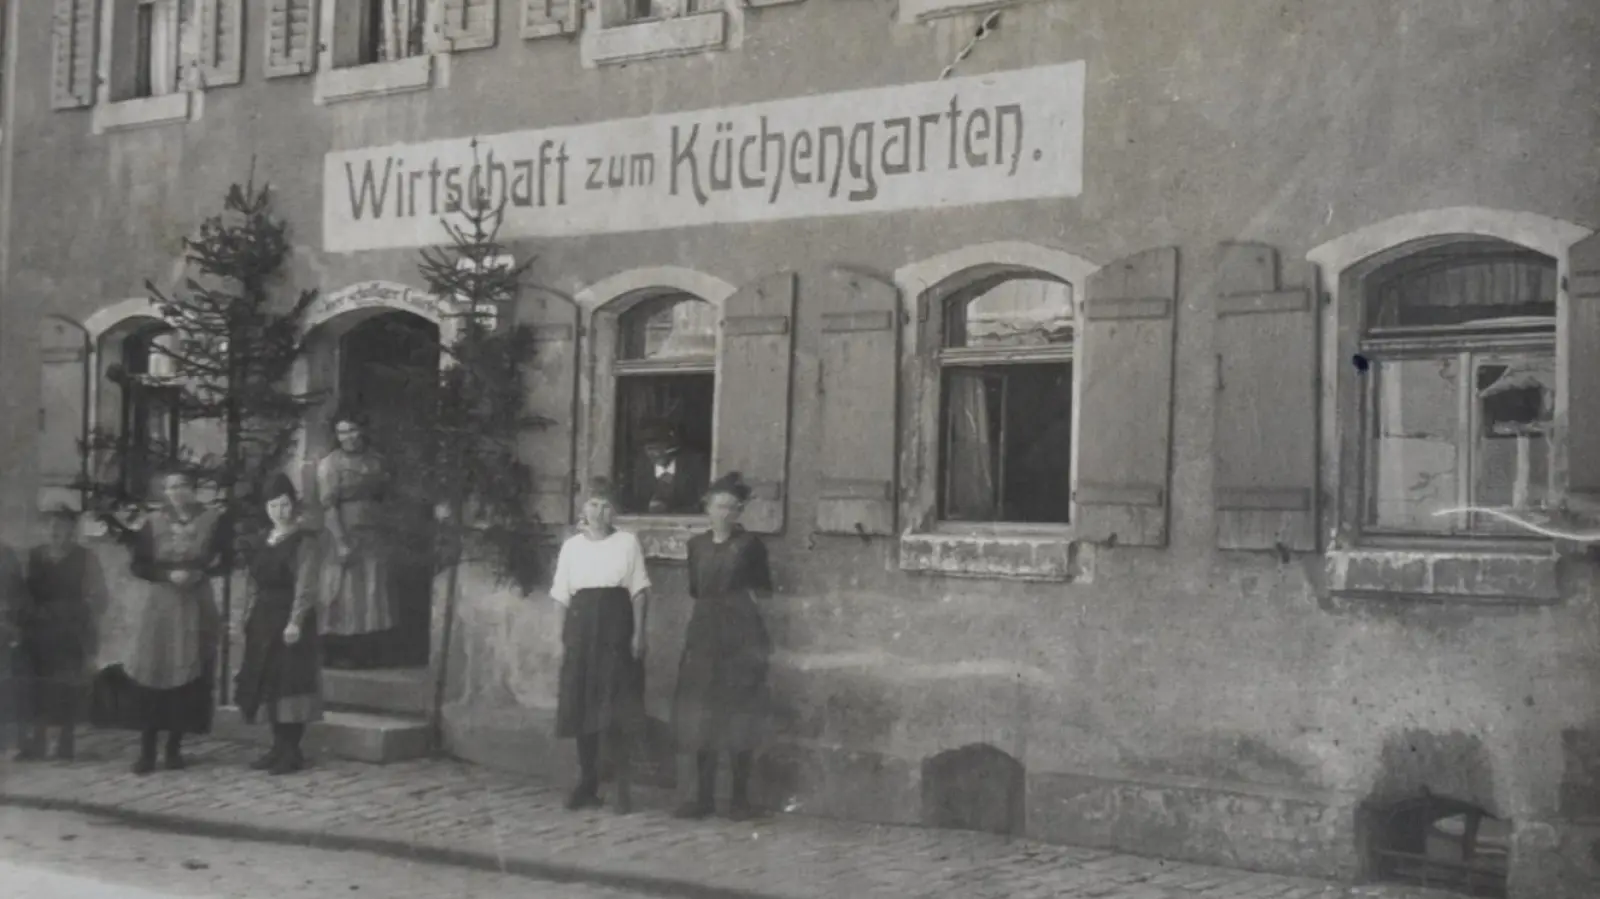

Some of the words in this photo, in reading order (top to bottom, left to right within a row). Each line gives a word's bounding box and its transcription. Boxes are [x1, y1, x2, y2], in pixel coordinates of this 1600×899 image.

[345, 139, 569, 220] Wirtschaft
[585, 151, 655, 190] zum
[668, 93, 1043, 205] Küchengarten.
